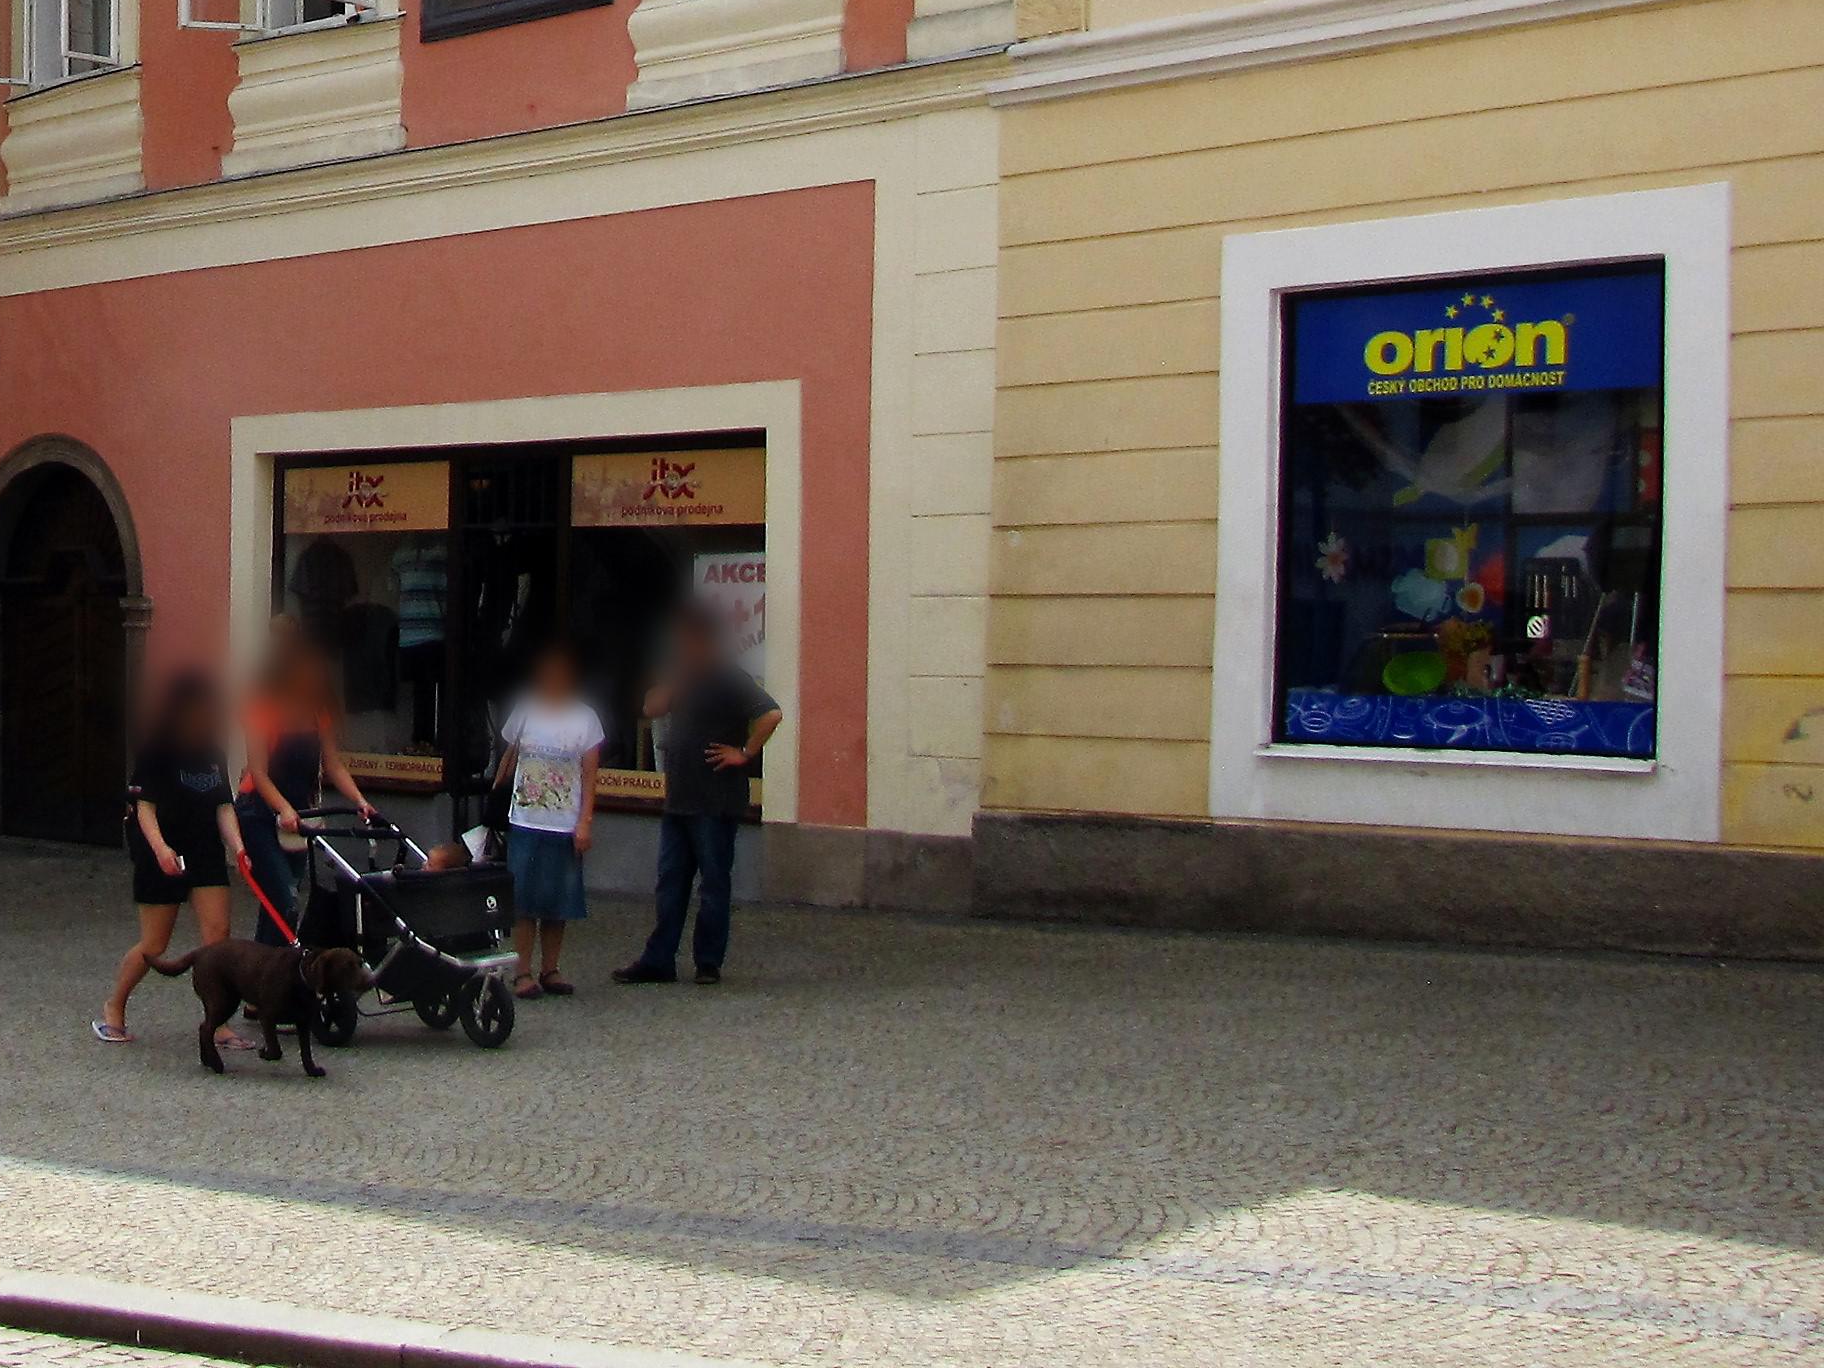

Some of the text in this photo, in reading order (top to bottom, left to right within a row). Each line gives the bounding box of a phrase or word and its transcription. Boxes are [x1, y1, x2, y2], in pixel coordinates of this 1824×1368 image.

[1408, 377, 1459, 394] OBCHOD
[1461, 375, 1485, 391] PRO
[676, 502, 724, 518] prodejna
